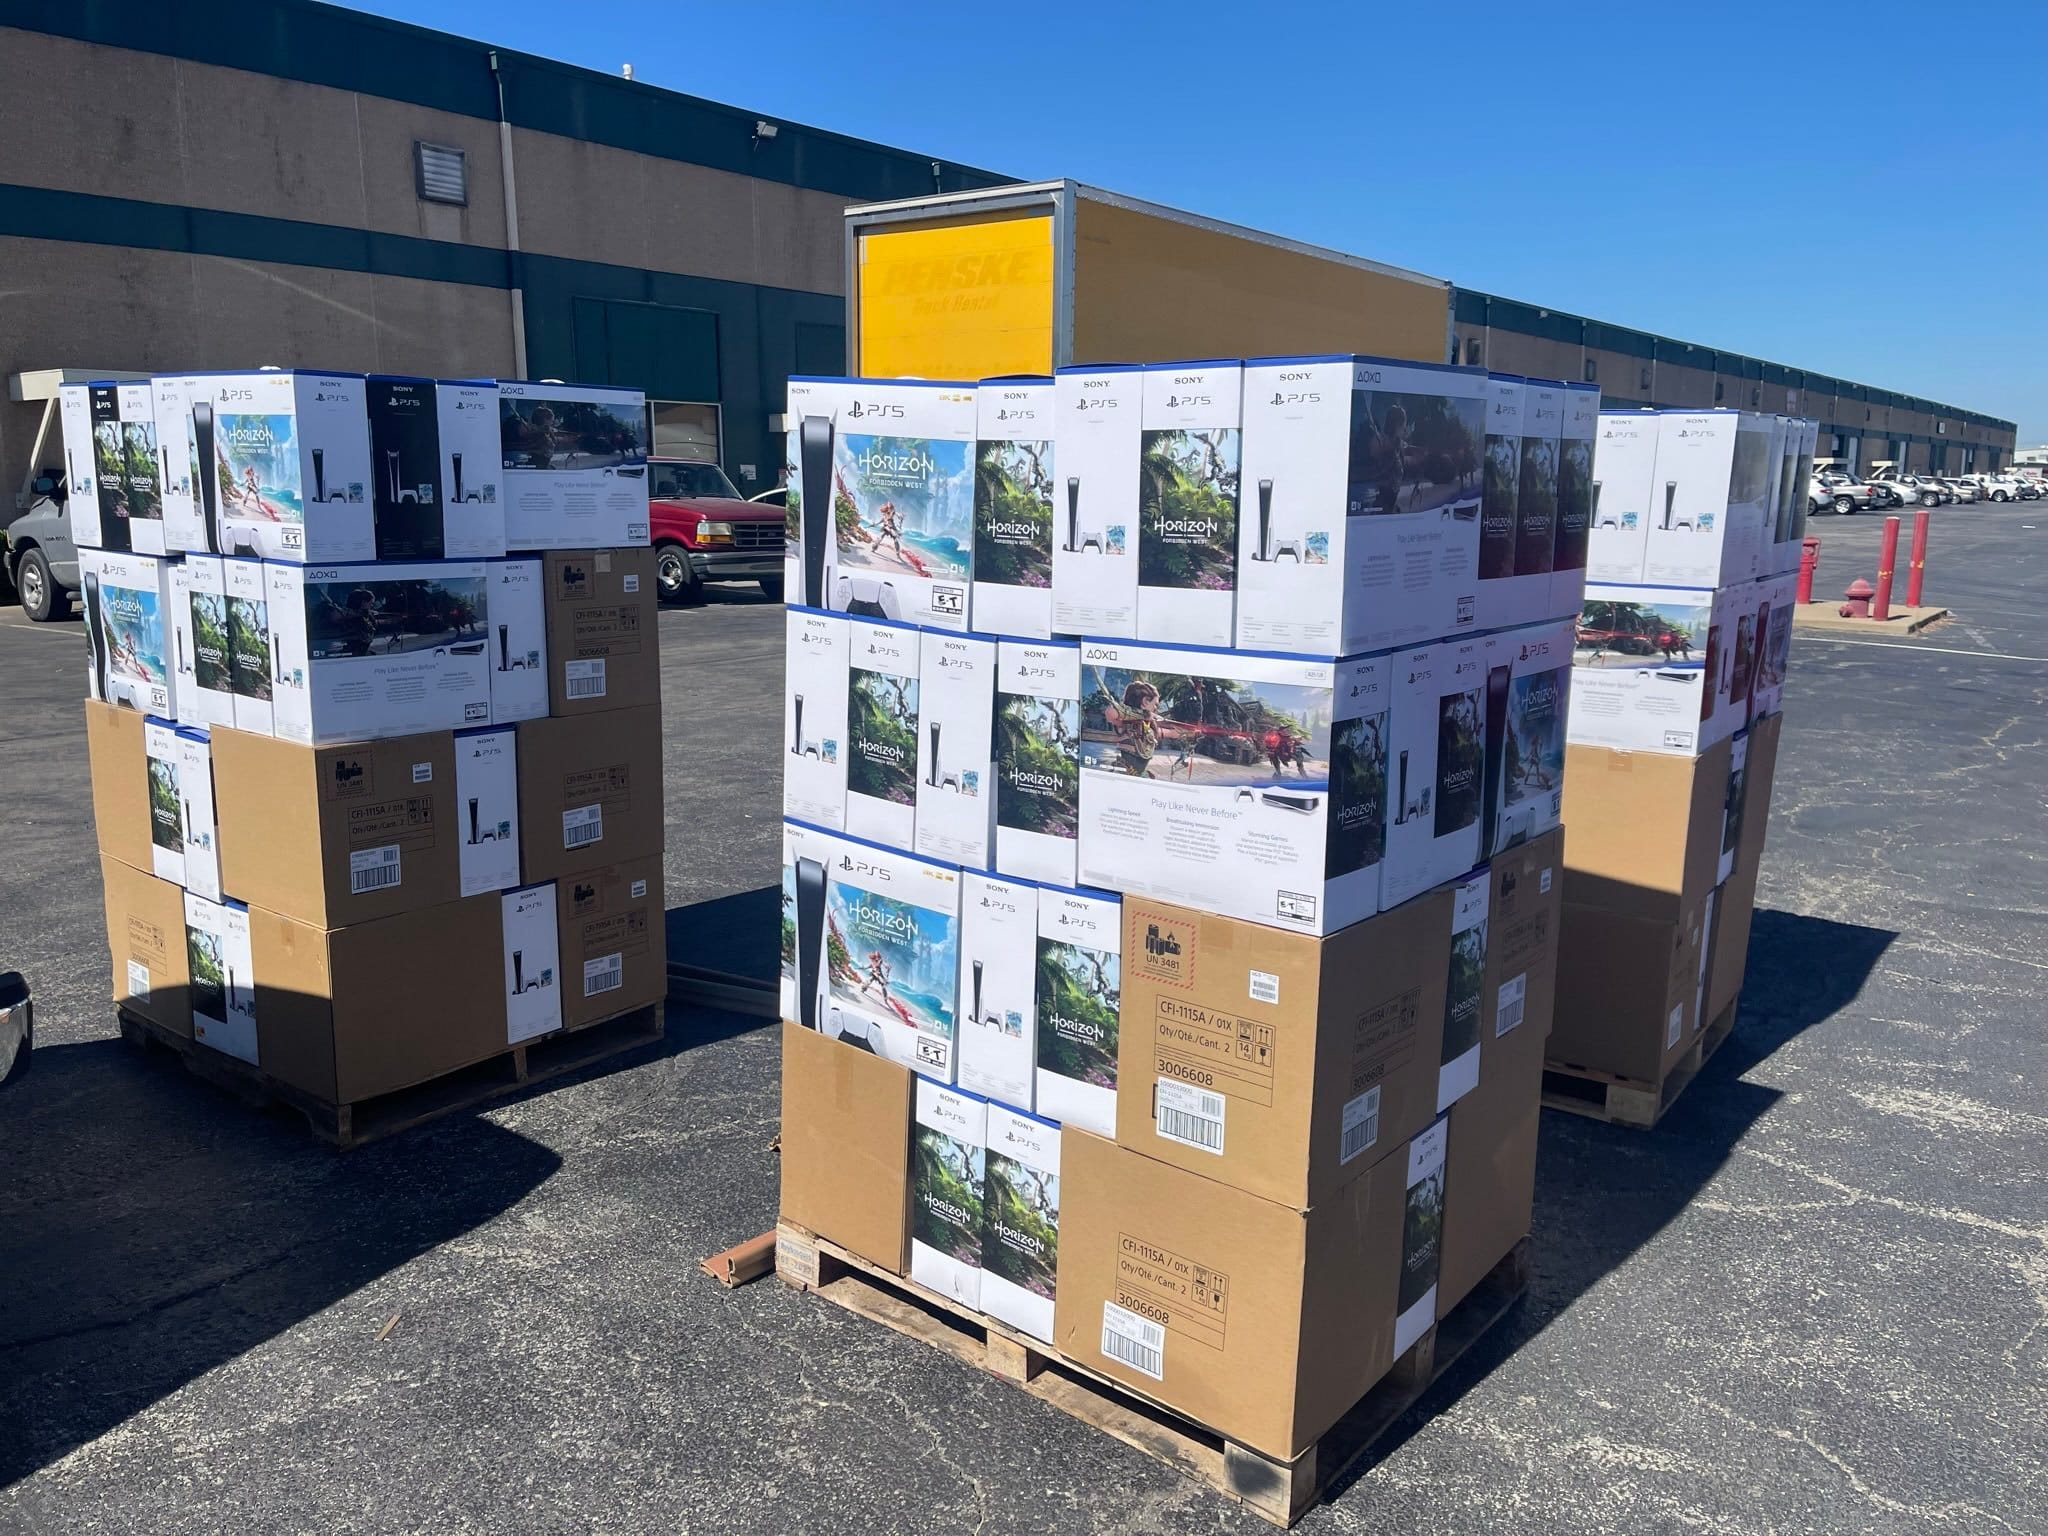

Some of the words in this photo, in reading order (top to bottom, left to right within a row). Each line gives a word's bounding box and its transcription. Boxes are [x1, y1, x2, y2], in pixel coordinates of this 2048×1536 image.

[1174, 376, 1204, 384] SONY
[1279, 372, 1312, 381] SONY
[1084, 380, 1110, 388] SONY
[231, 390, 253, 400] PS5
[791, 387, 811, 395] SONY
[1004, 392, 1028, 400] SONY
[399, 399, 420, 407] PS5
[1181, 396, 1211, 406] PS5
[1287, 392, 1321, 403] PS5
[1090, 399, 1118, 408] PS5
[867, 404, 905, 418] PS5
[1010, 410, 1035, 420] PS5
[1502, 407, 1517, 416] PS5
[229, 424, 273, 447] HORIZON
[1615, 431, 1639, 439] PS5
[1690, 430, 1715, 438] PS5
[859, 447, 934, 480] HORIZON
[869, 478, 904, 488] FORBIDDEN
[905, 481, 923, 489] WEST
[1154, 515, 1218, 537] HORIZON
[1483, 512, 1513, 530] HORIZON
[987, 517, 1040, 540] HORIZON
[110, 565, 127, 576] PS5
[110, 598, 143, 617] HORIZON
[807, 619, 826, 628] SONY
[873, 630, 894, 639] SONY
[812, 636, 832, 646] PS5
[944, 642, 967, 651] SONY
[198, 644, 222, 660] HORIZON
[878, 647, 900, 657] PS5
[1024, 650, 1048, 659] SONY
[1529, 643, 1549, 657] PS5
[236, 650, 262, 666] HORIZON
[950, 659, 973, 670] PS5
[1357, 665, 1374, 674] SONY
[1463, 662, 1477, 671] PS5
[1030, 667, 1055, 678] PS5
[1416, 670, 1431, 680] PS5
[1360, 683, 1377, 694] PS5
[1522, 687, 1559, 706] HORIZON
[859, 737, 904, 762] HORIZON
[1009, 767, 1063, 793] HORIZON
[1444, 767, 1474, 787] HORIZON
[351, 806, 386, 819] CFI-1115A
[1151, 798, 1167, 809] Play
[1168, 801, 1183, 811] Like
[1185, 804, 1209, 816] Never
[1337, 801, 1377, 825] HORIZON
[787, 828, 803, 838] SONY
[857, 863, 891, 881] PS5
[986, 883, 1009, 894] SONY
[992, 901, 1016, 912] PS5
[1064, 900, 1089, 910] SONY
[849, 898, 918, 936] HORIZON
[1071, 919, 1096, 930] PS5
[858, 926, 890, 942] FORBIDDEN
[891, 936, 908, 947] WEST
[1146, 954, 1159, 965] UN
[1161, 957, 1180, 970] 3481
[1451, 992, 1480, 1018] HORIZON
[1160, 1000, 1206, 1025] CFI-1115A
[1216, 1018, 1232, 1031] 01X
[1050, 1012, 1104, 1040] HORIZON
[1159, 1024, 1221, 1050] Qty/Qté./Cant.
[1224, 1042, 1231, 1053] 2
[1240, 1042, 1249, 1053] 14
[1159, 1060, 1213, 1086] 3006608
[1353, 1064, 1385, 1090] 3006608
[939, 1093, 960, 1106] SONY
[945, 1109, 966, 1125] PS5
[1011, 1118, 1035, 1133] SONY
[1018, 1137, 1041, 1152] PS5
[924, 1191, 971, 1223] HORIZON
[994, 1220, 1045, 1254] HORIZON
[1122, 1238, 1165, 1266] CFI-1115A
[1174, 1261, 1189, 1275] 01X
[1180, 1284, 1186, 1295] 2
[1195, 1286, 1204, 1296] 14
[1119, 1293, 1169, 1324] 3006608
